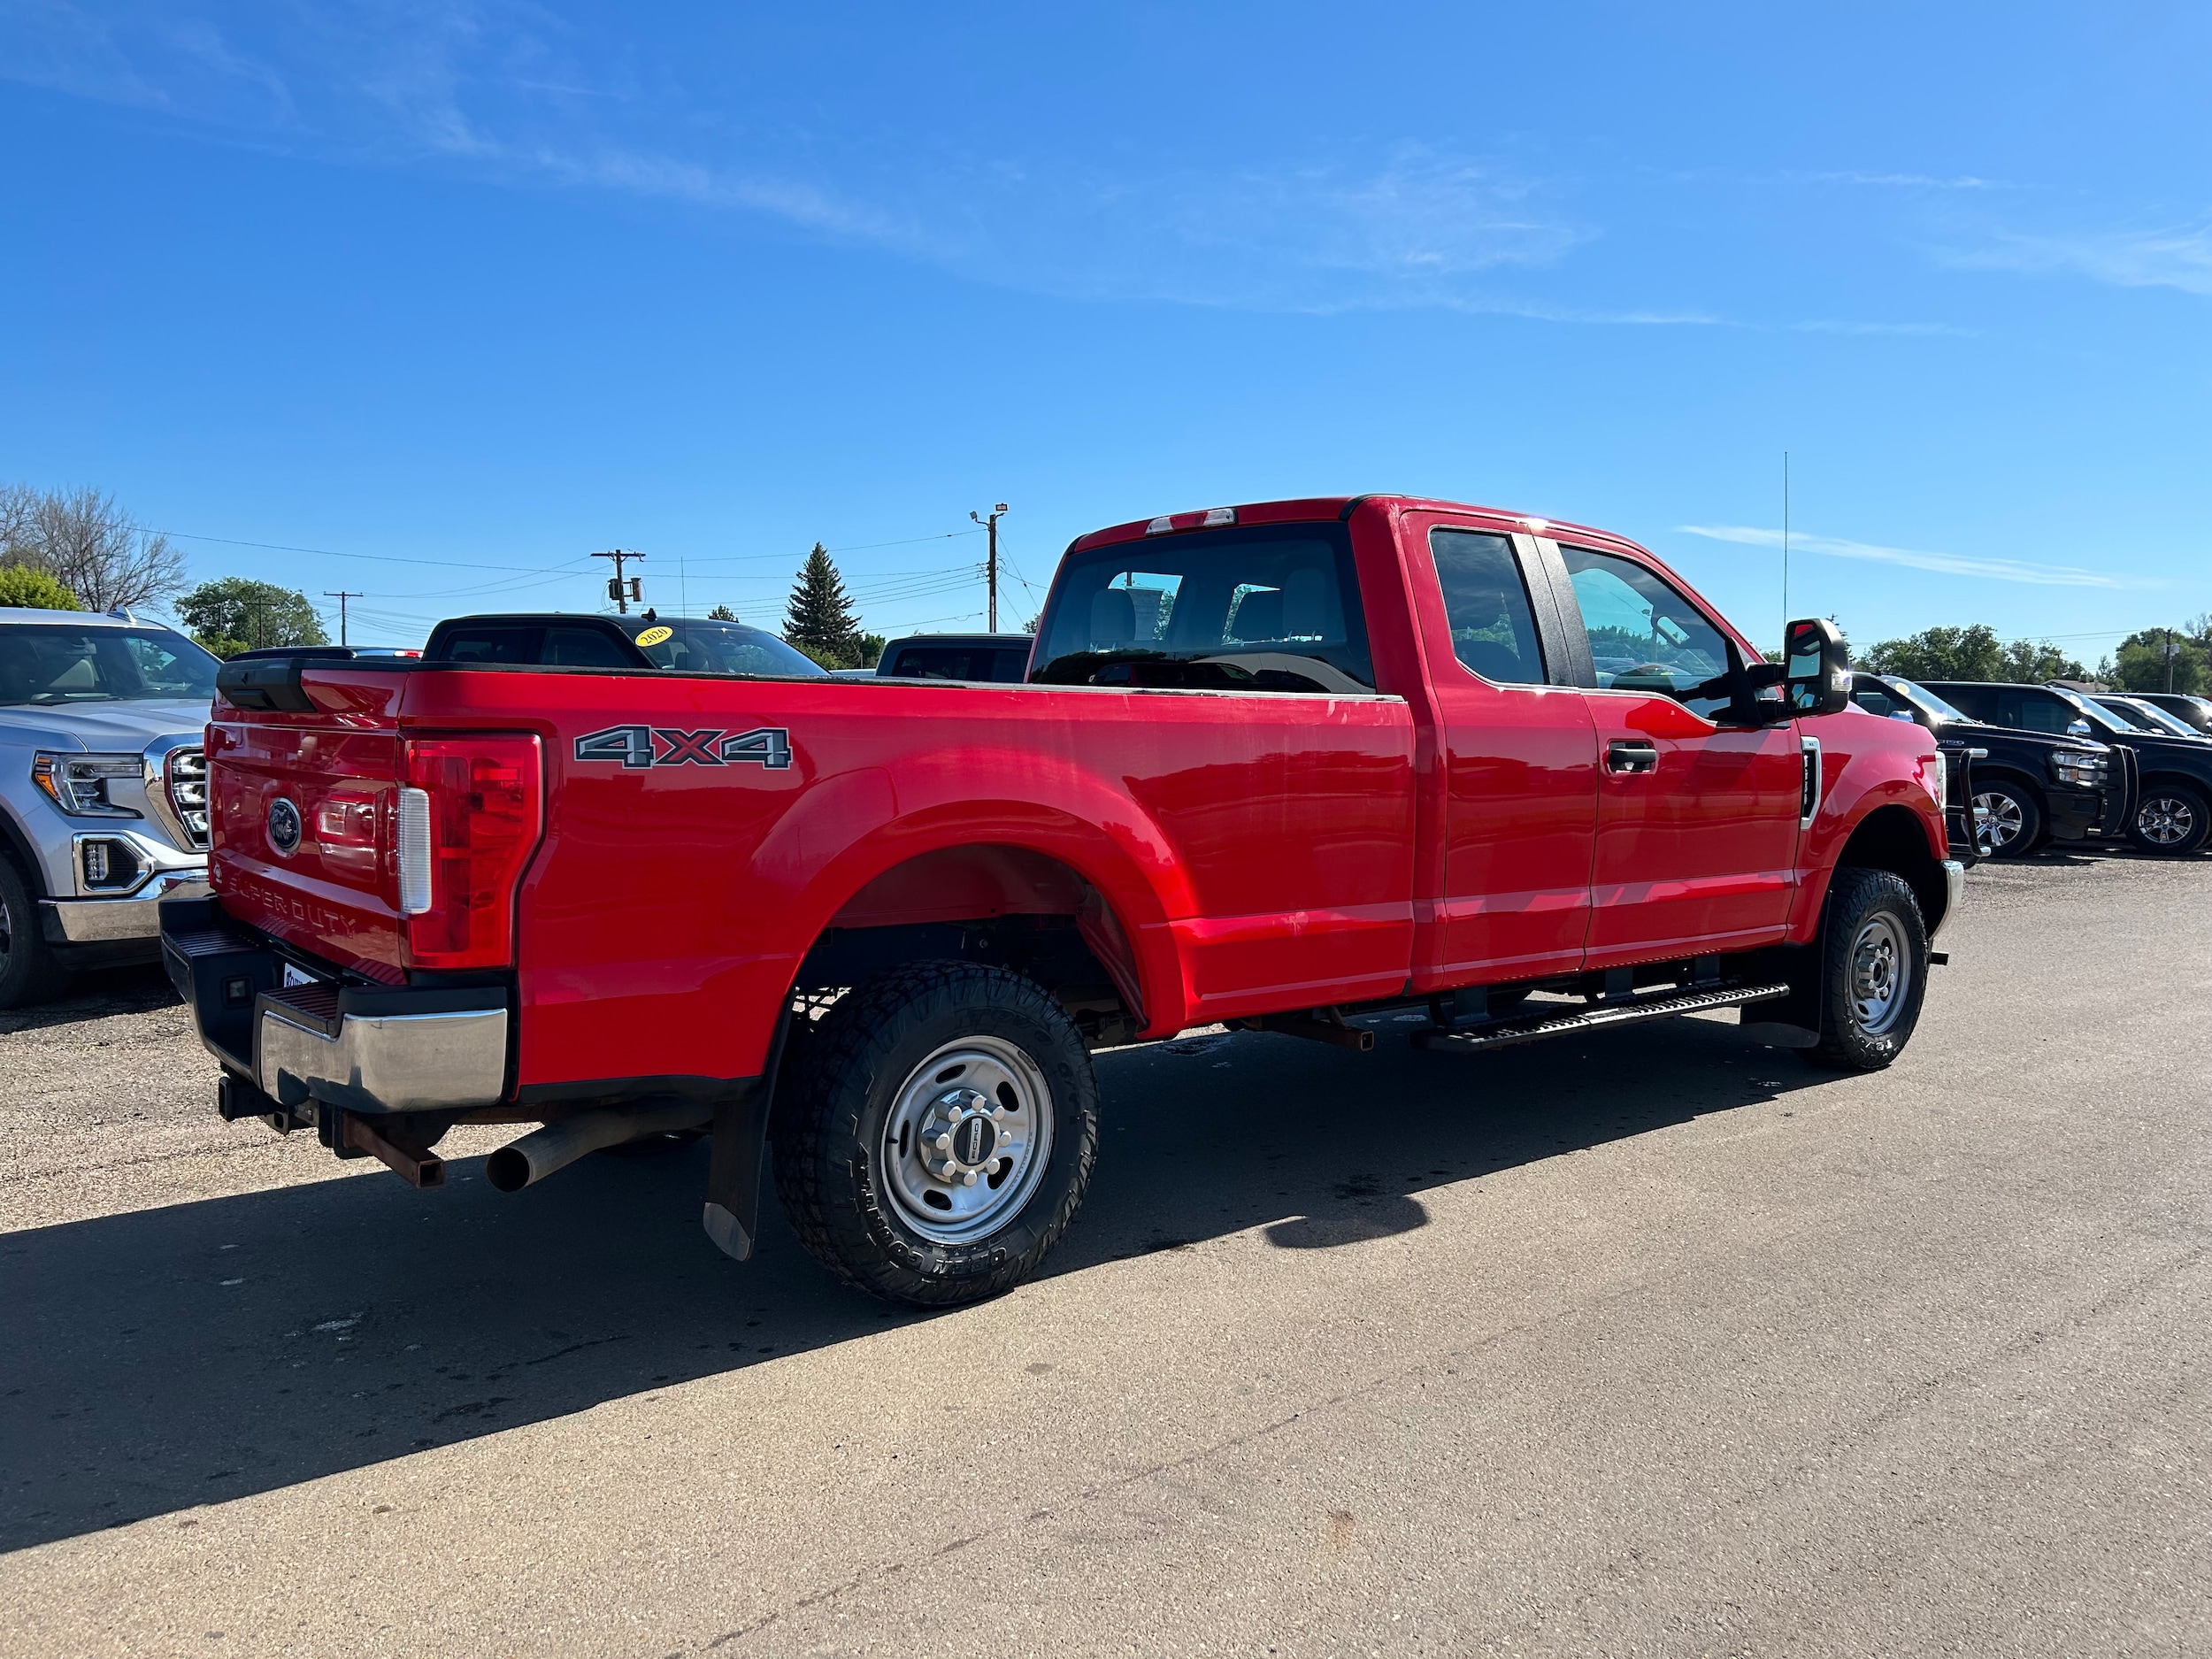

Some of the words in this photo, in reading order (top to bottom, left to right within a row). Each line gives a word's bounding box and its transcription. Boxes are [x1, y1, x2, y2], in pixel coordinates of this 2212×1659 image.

[641, 628, 668, 644] 2020
[229, 877, 288, 914] SUPER
[291, 898, 356, 939] DUTY
[971, 1123, 979, 1159] FORD
